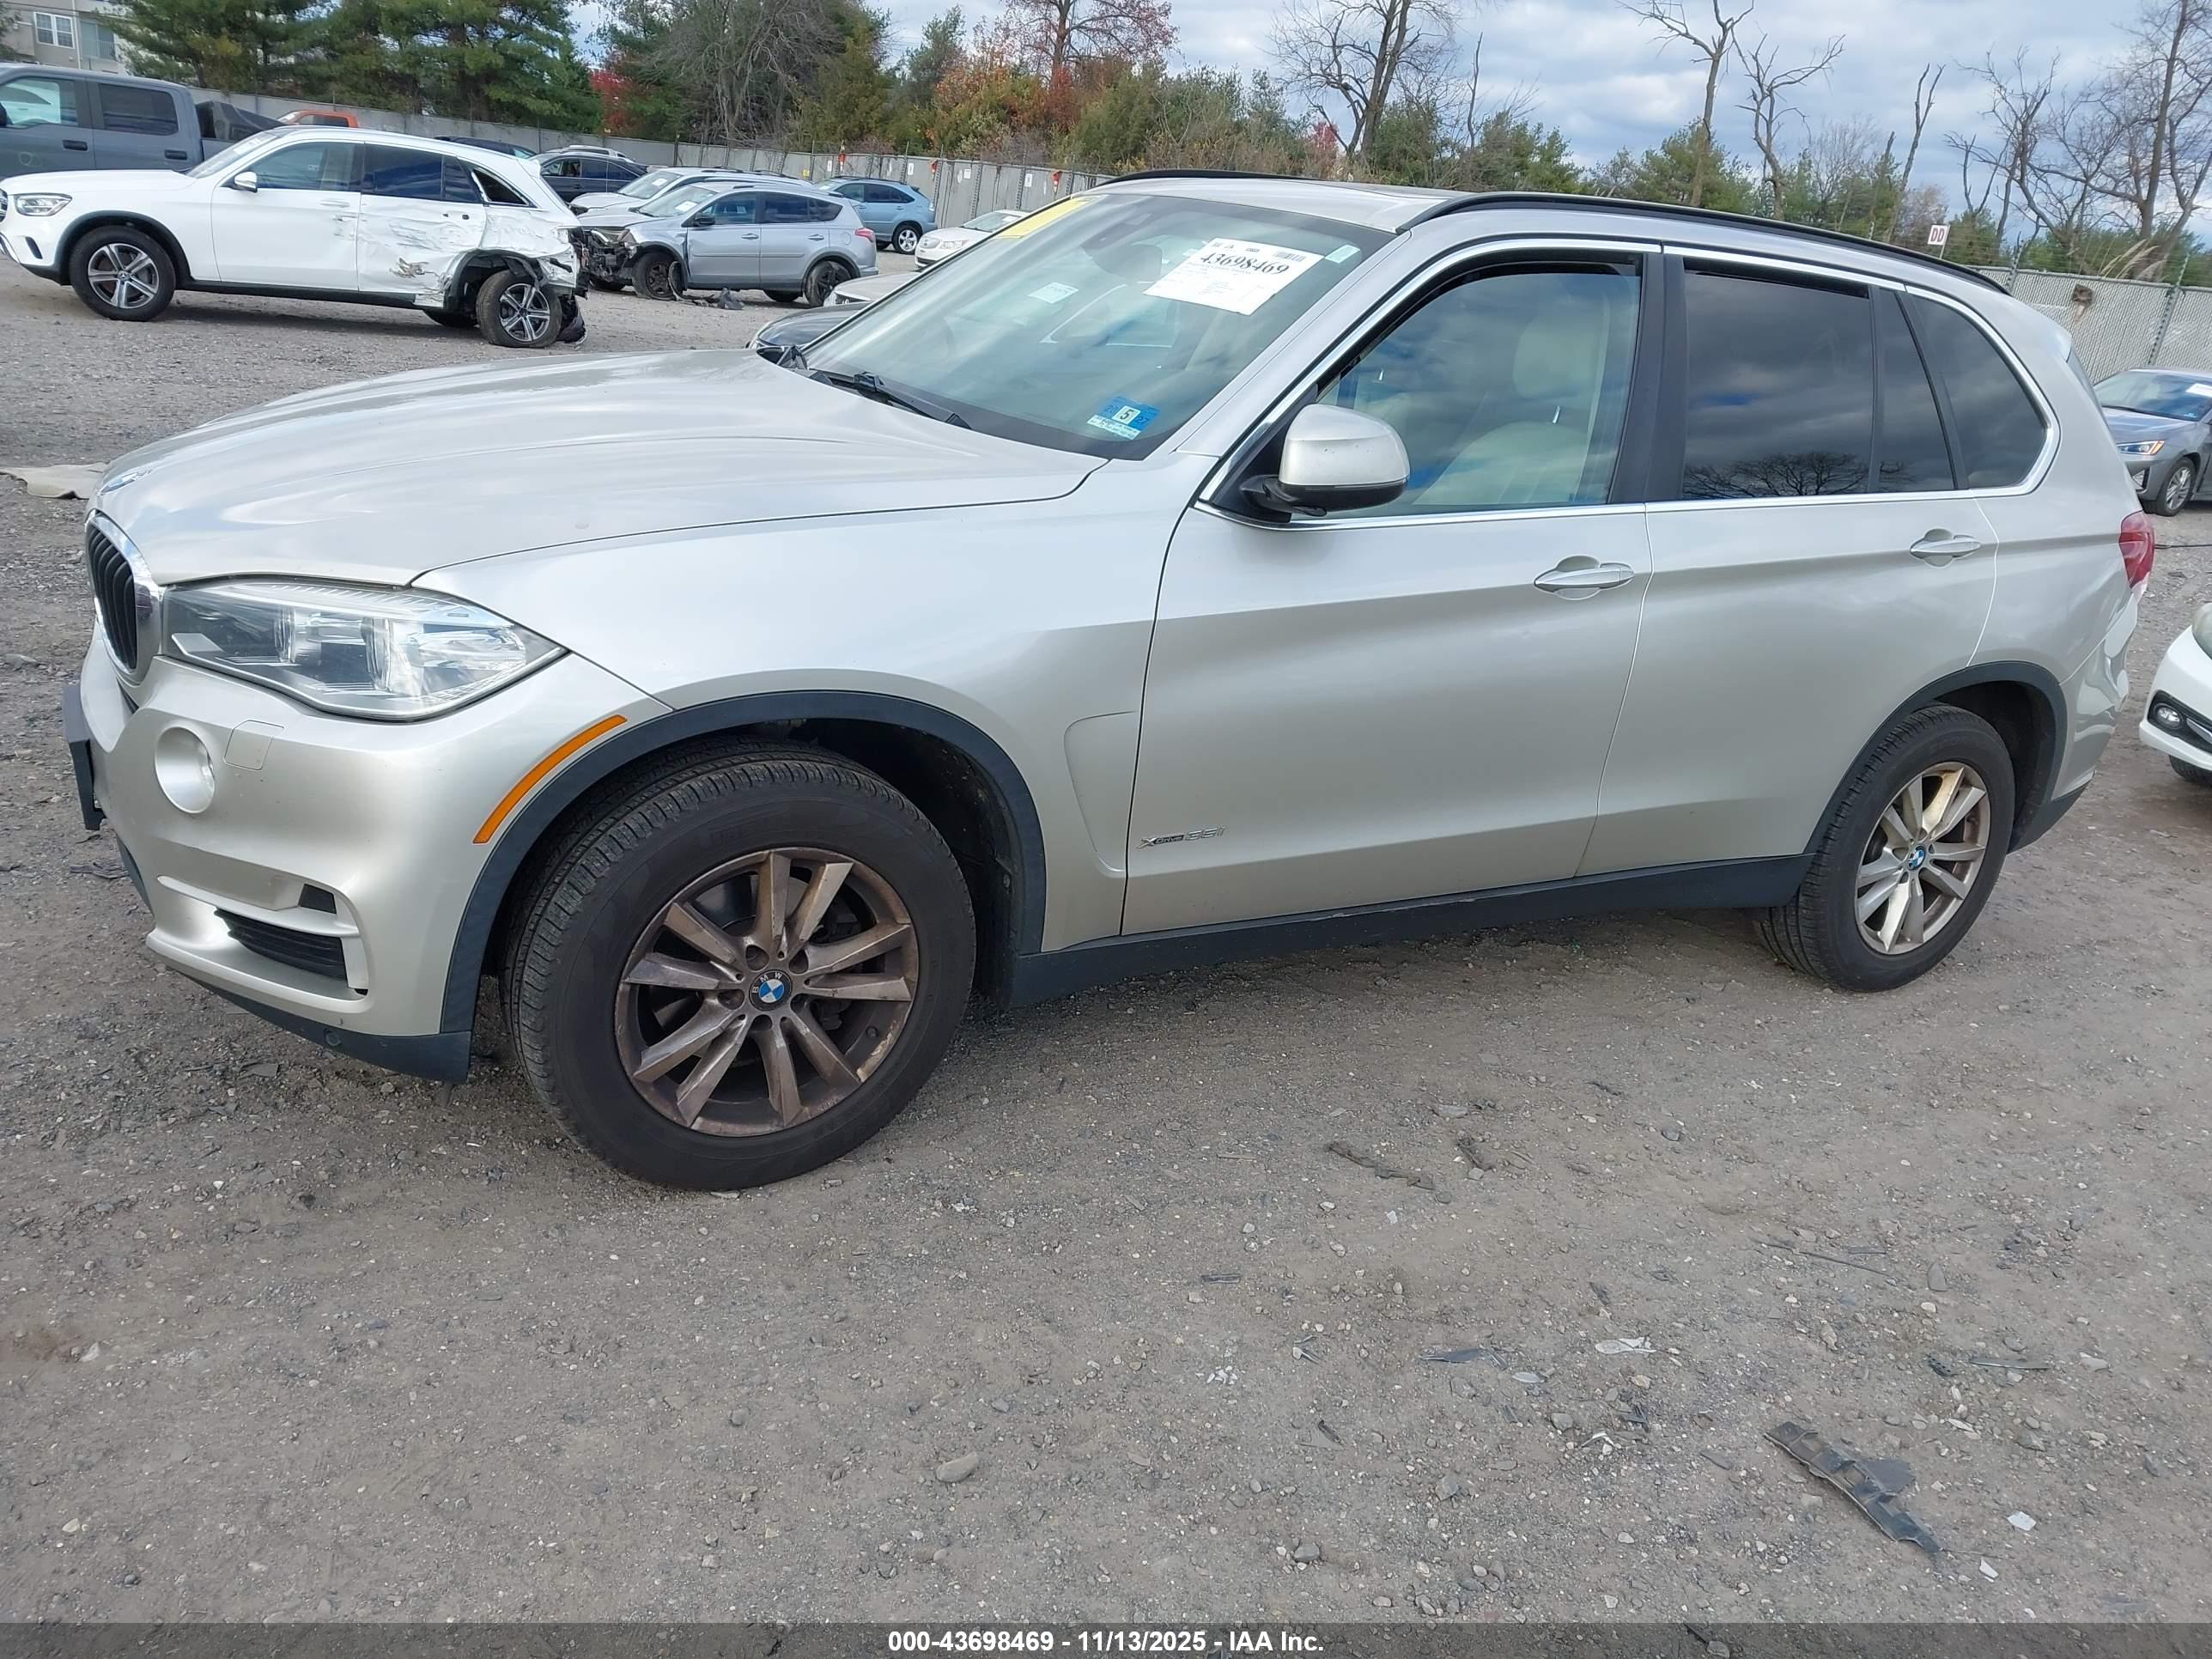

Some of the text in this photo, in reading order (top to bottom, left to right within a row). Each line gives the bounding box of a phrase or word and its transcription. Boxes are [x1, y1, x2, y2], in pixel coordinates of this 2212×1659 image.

[1930, 228, 1945, 242] DD
[1200, 252, 1290, 275] 43698469
[1119, 409, 1134, 420] 5
